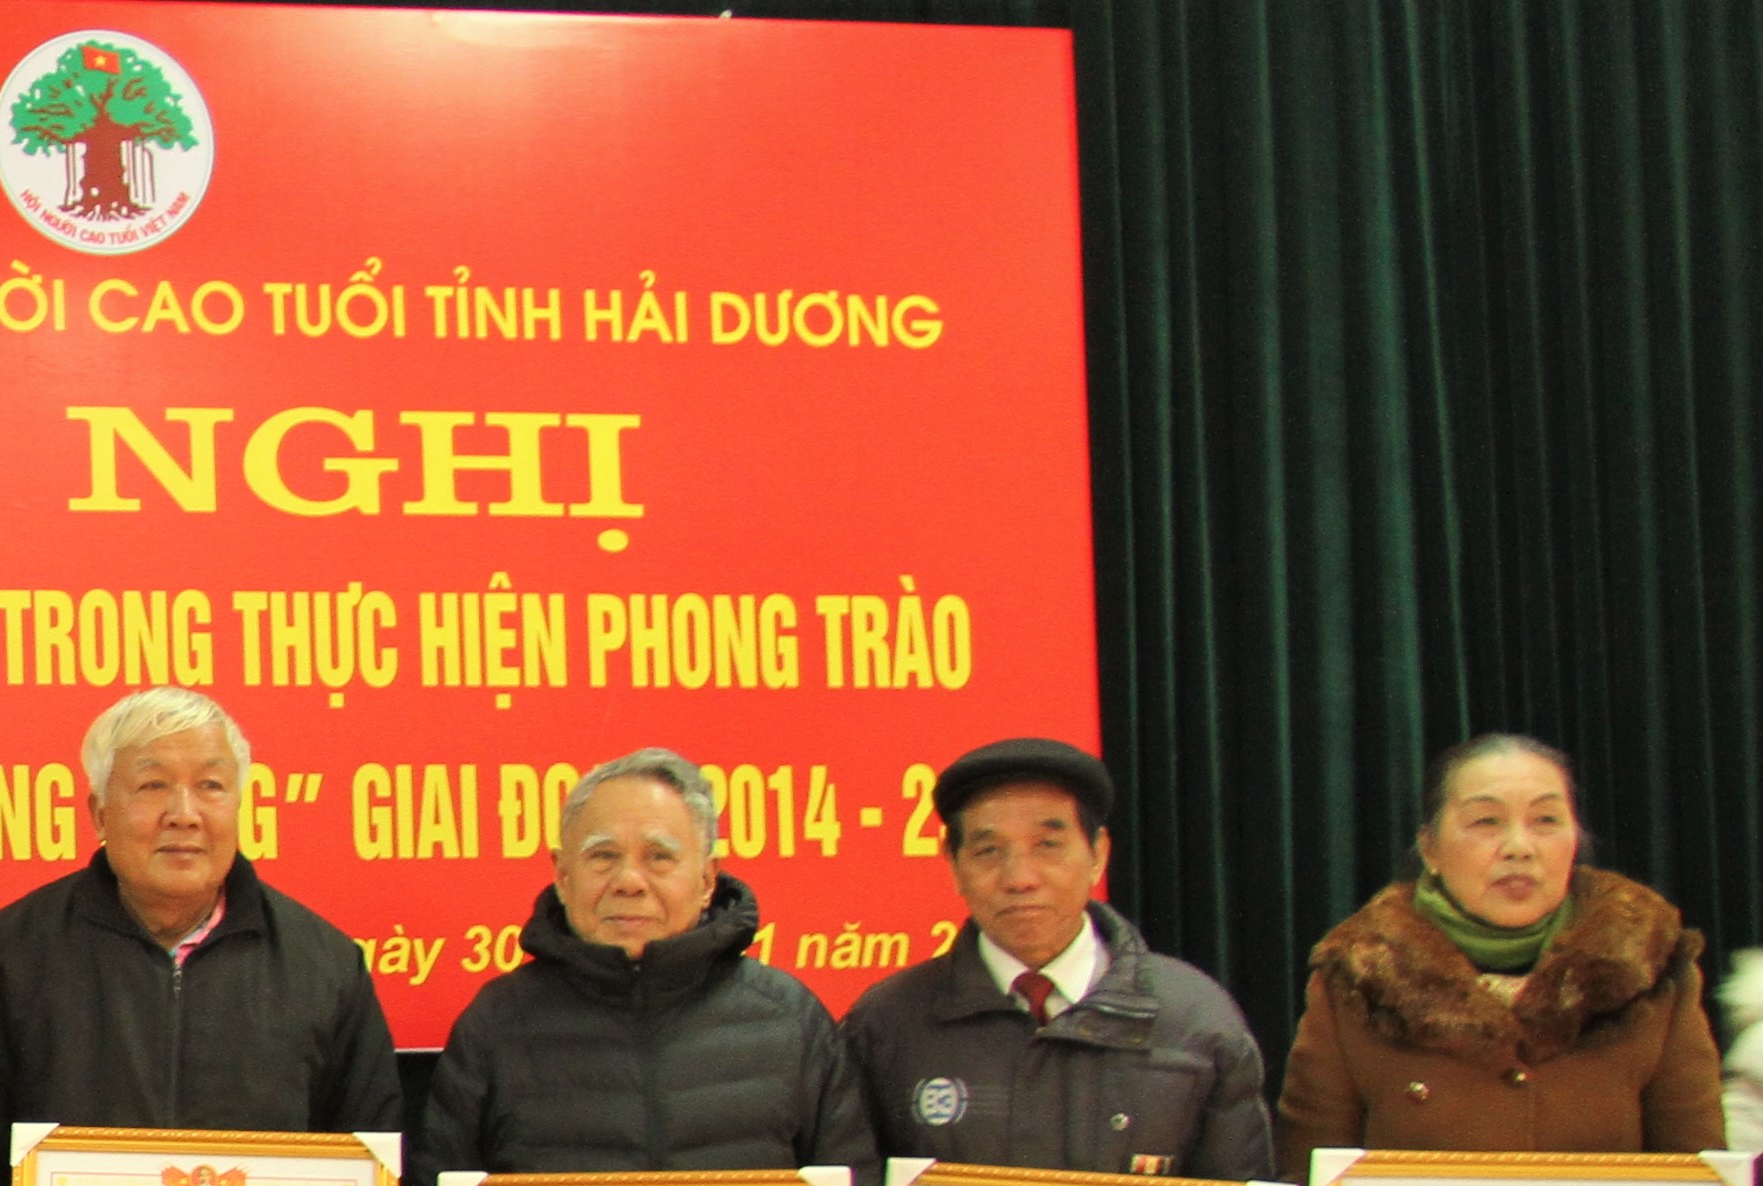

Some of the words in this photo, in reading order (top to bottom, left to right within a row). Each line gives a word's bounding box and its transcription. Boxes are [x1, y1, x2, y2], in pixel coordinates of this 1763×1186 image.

[20, 189, 41, 211] HỘI
[40, 208, 77, 238] NGƯỜI
[79, 228, 105, 245] CAO
[108, 223, 138, 245] TUỔI
[140, 215, 168, 237] VIỆT
[166, 190, 191, 217] NAM
[88, 279, 244, 335] CAO
[269, 257, 406, 338] TUỔI
[425, 266, 561, 340] TỈNH
[584, 270, 688, 343] HẢI
[711, 290, 942, 348] DƯƠNG
[65, 406, 644, 552] NGHỊ
[233, 582, 398, 708] THỰC
[419, 572, 567, 709] HIỆN
[587, 593, 800, 689] PHONG
[816, 575, 971, 689] TRÀO
[353, 763, 478, 860] GIAI
[498, 762, 581, 859] ĐO
[700, 763, 842, 860] 2014
[902, 763, 947, 857] 2
[461, 924, 525, 973] 30
[795, 920, 910, 969] năm
